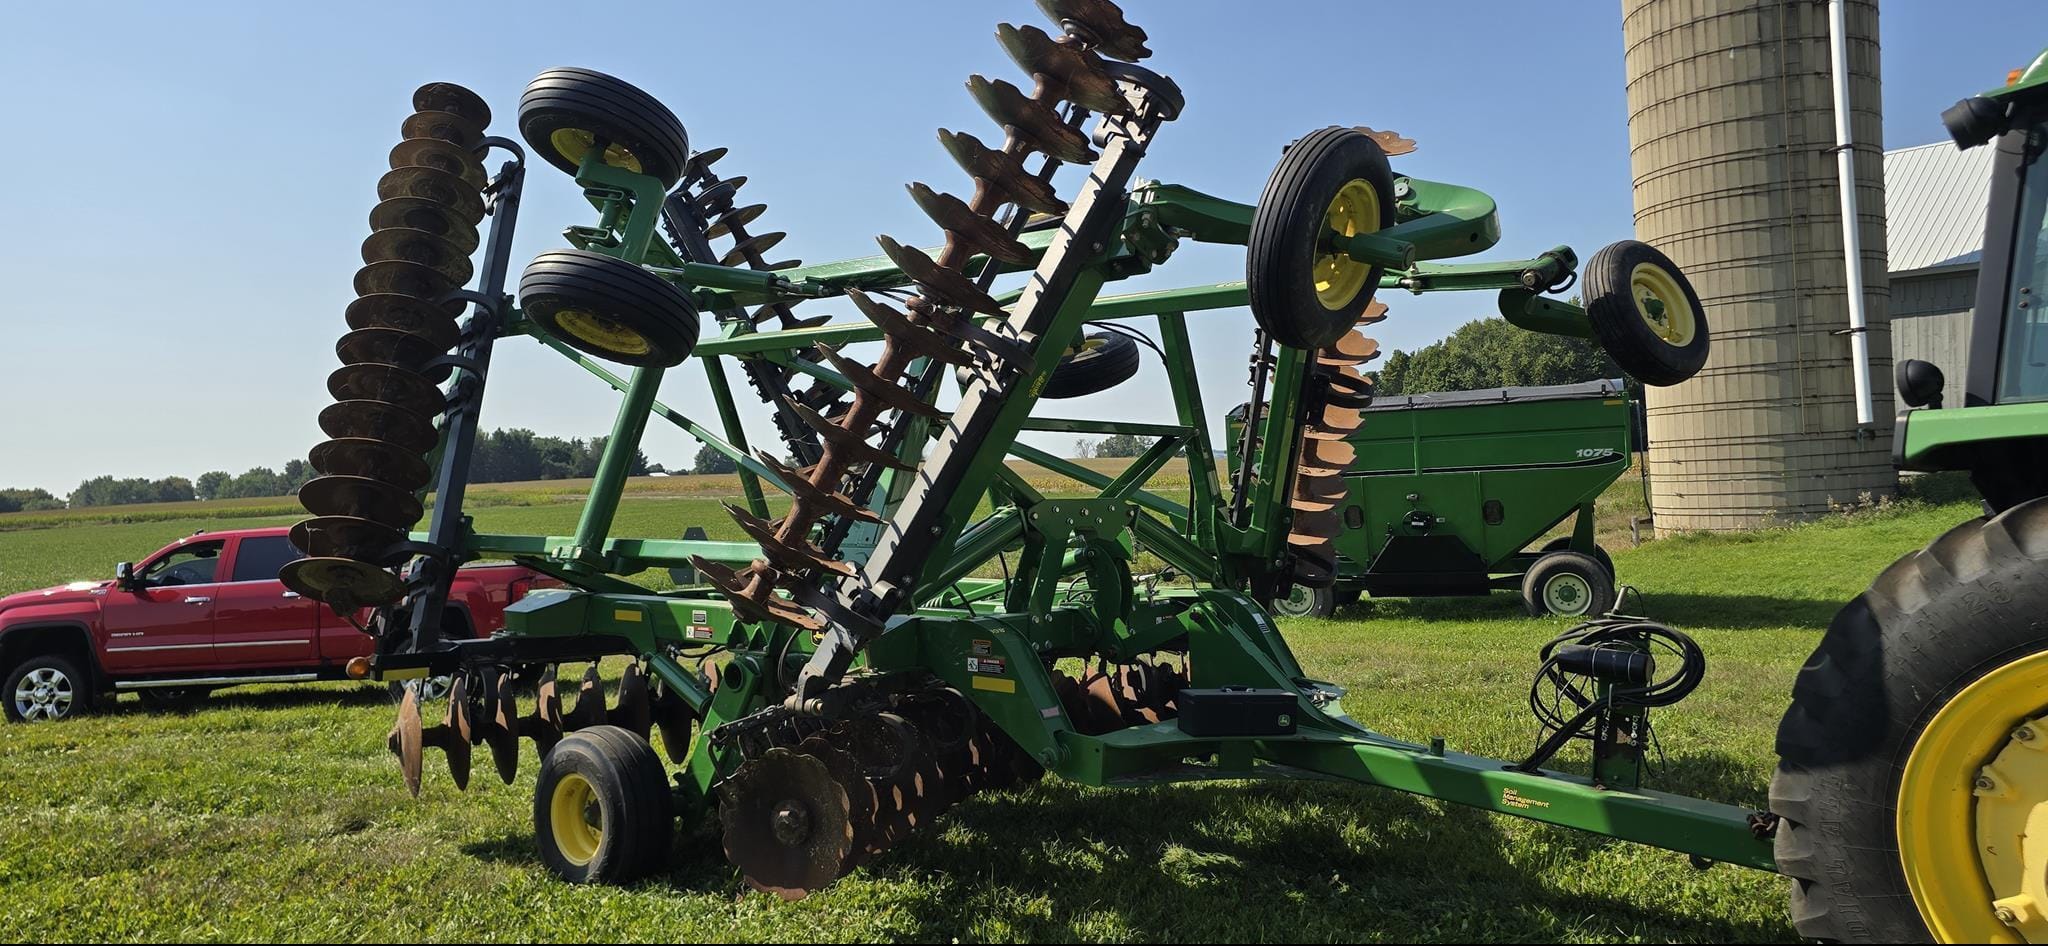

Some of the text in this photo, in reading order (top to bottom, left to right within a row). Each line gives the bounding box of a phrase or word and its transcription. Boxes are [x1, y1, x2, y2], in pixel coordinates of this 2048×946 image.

[1576, 448, 1614, 458] 1075
[1502, 799, 1529, 809] System
[1503, 794, 1549, 808] Management
